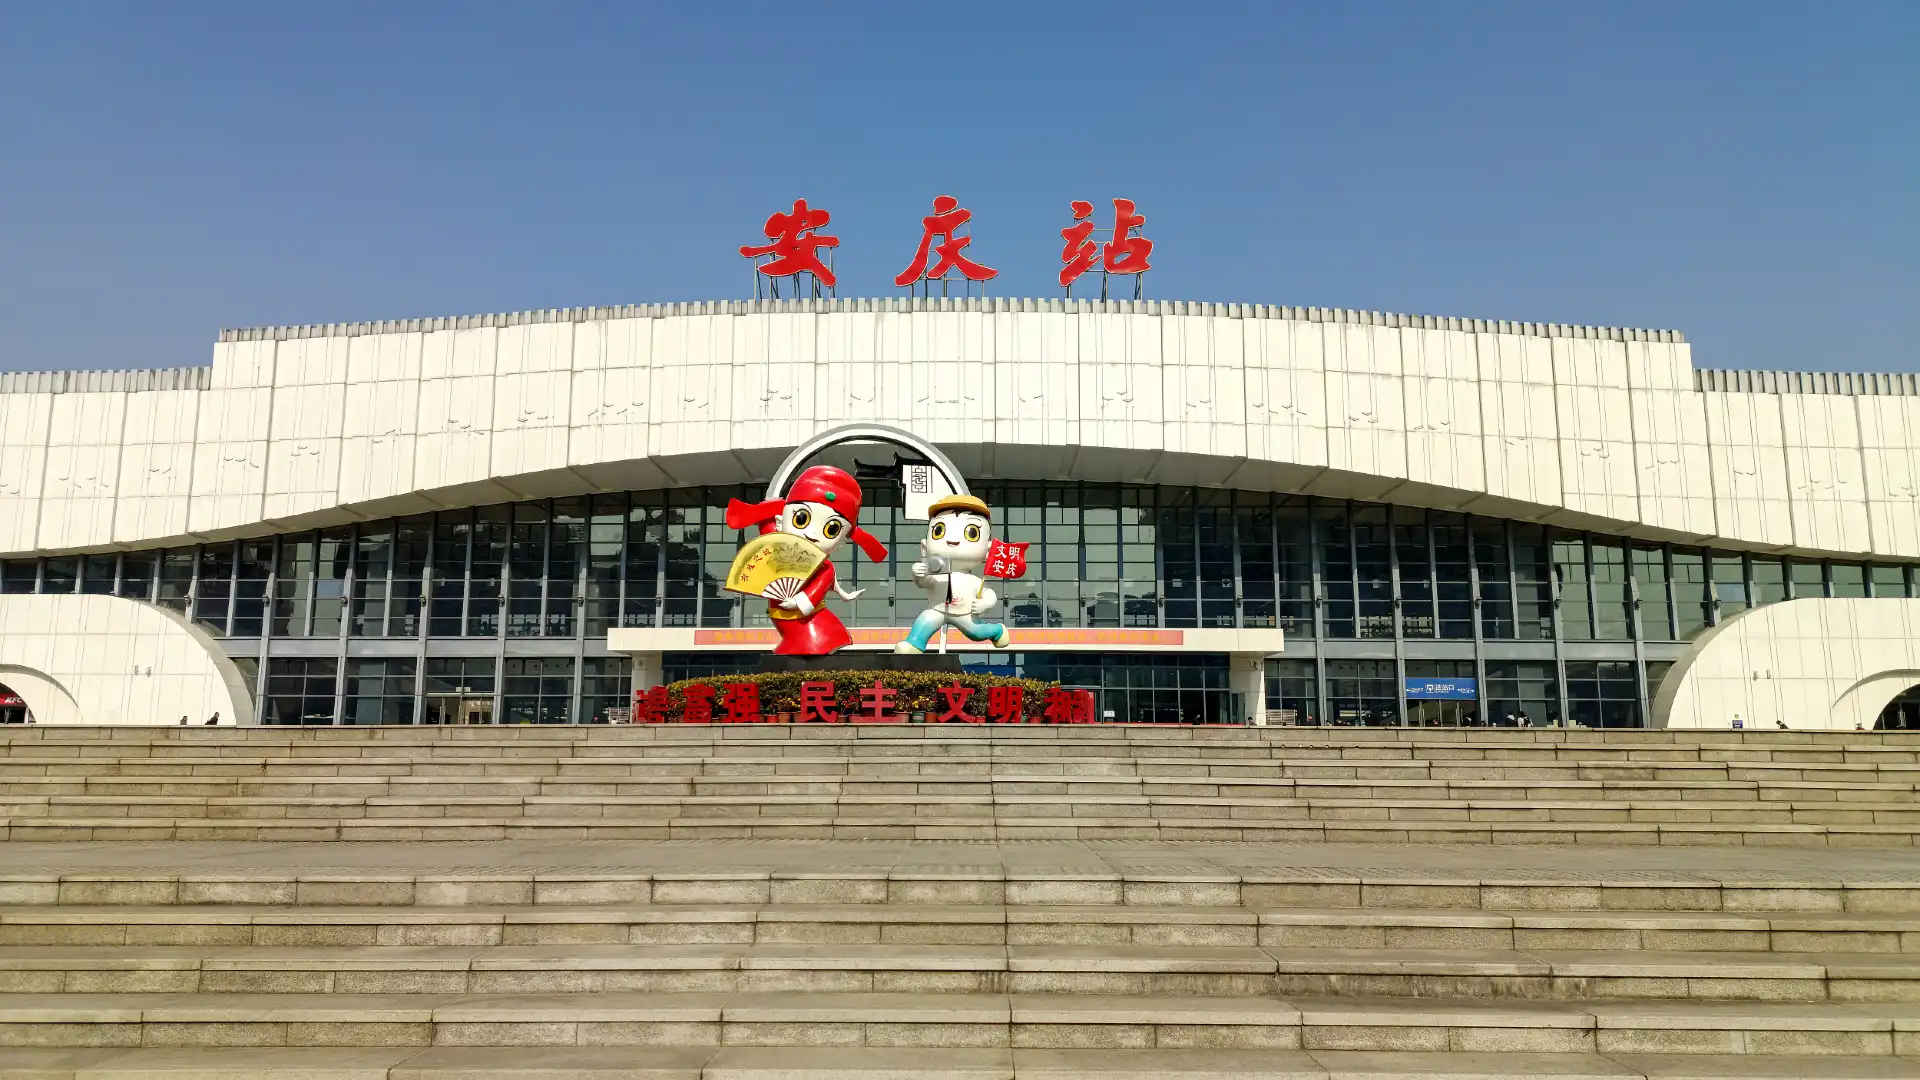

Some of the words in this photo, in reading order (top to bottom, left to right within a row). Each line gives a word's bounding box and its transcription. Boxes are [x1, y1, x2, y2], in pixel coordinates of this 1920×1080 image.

[739, 195, 1154, 287] 安庆站
[994, 544, 1021, 561] 文明
[992, 559, 1018, 576] 安庆
